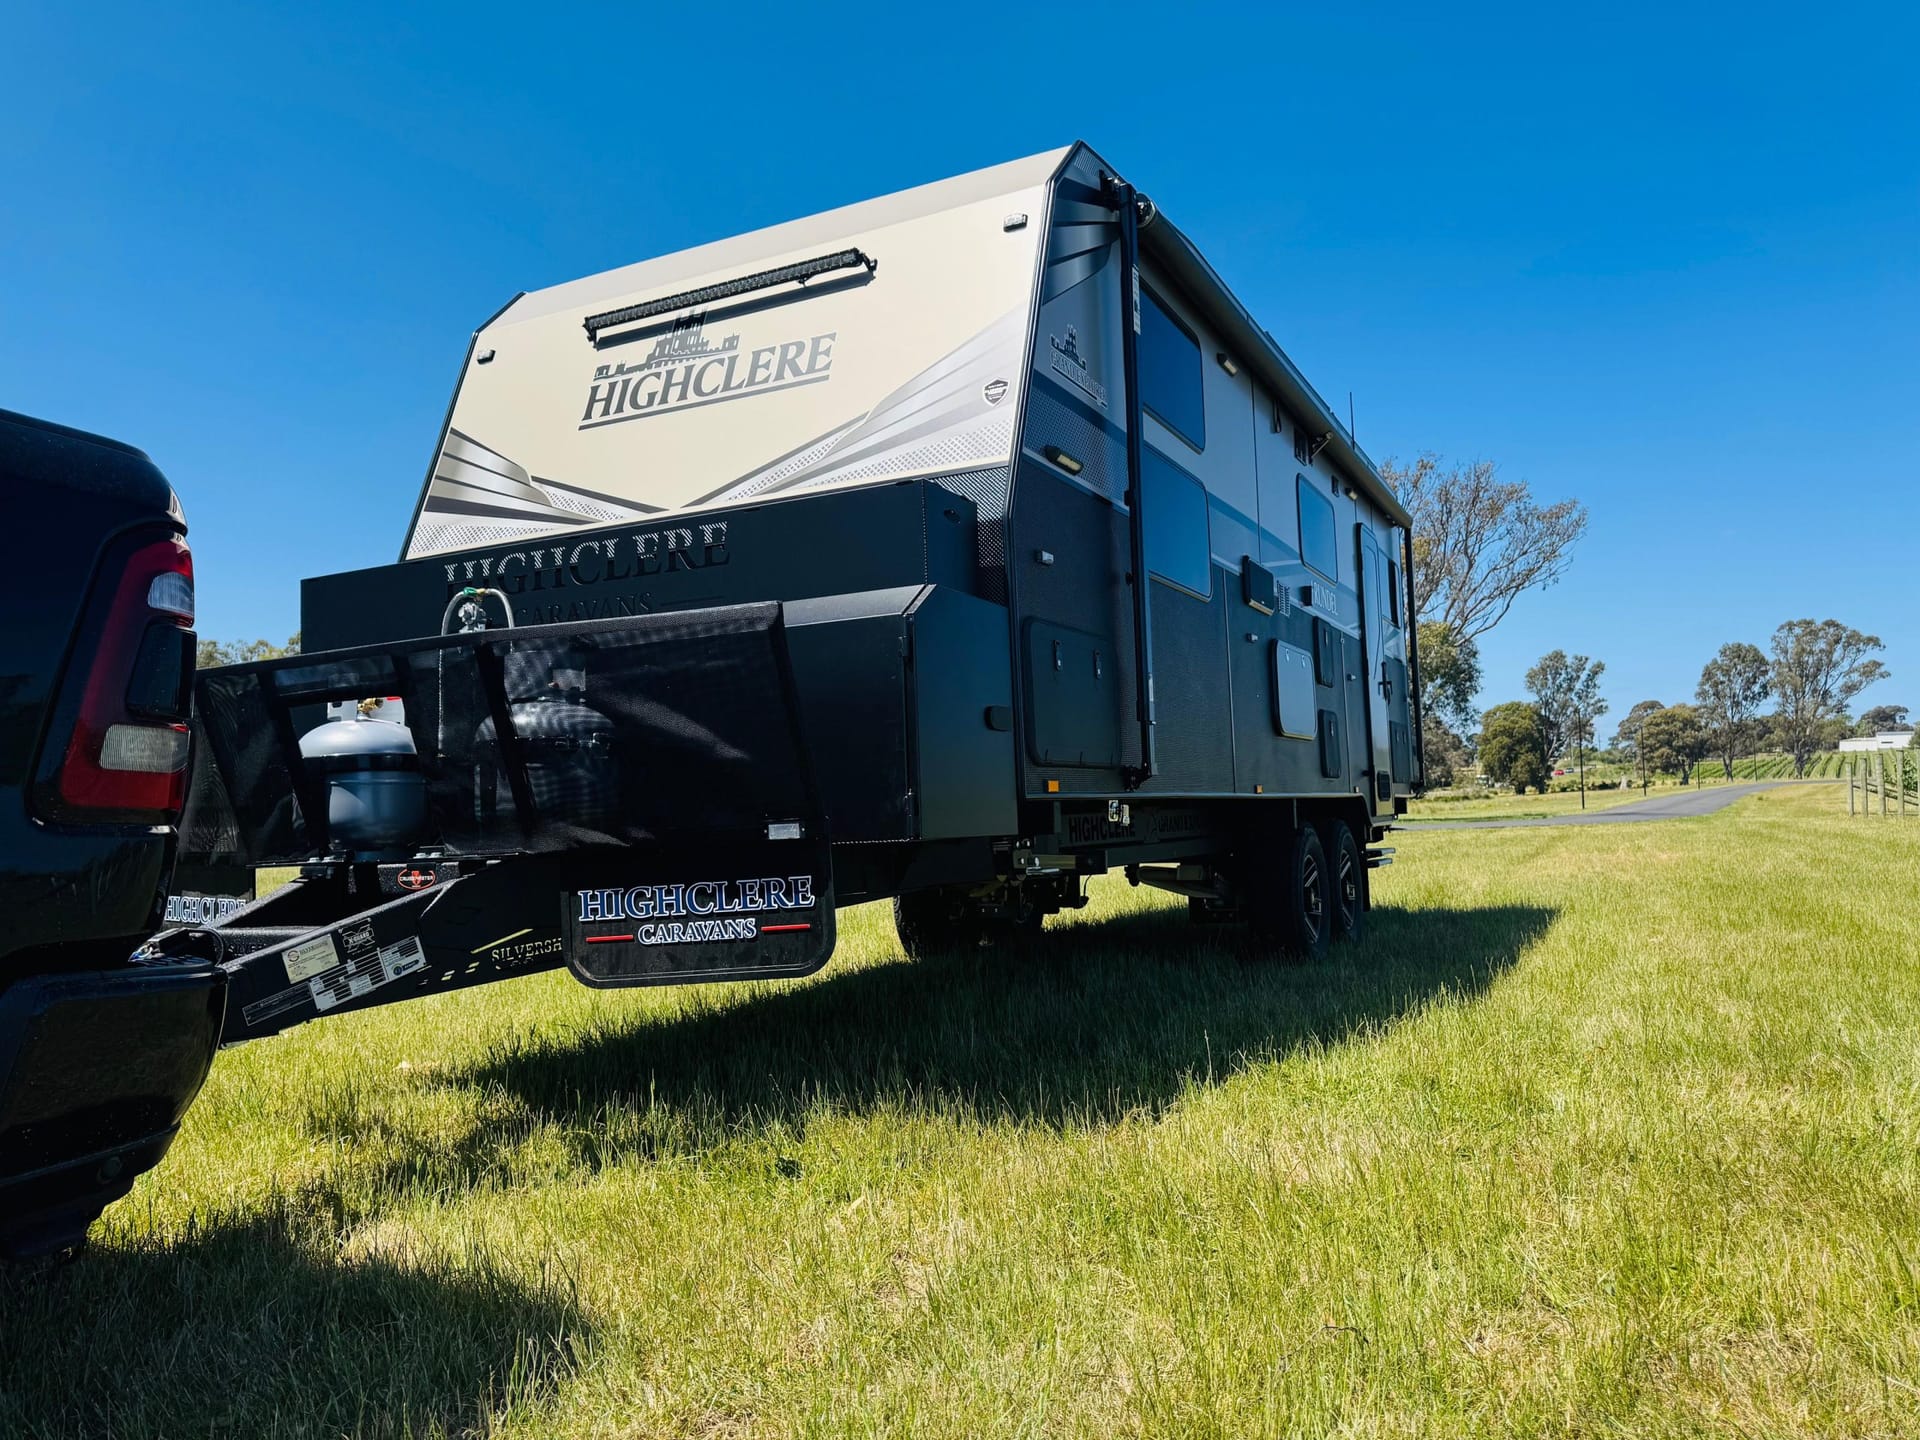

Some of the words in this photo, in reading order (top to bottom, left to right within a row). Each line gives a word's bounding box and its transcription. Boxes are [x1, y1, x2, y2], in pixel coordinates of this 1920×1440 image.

[582, 332, 837, 421] HIGHCLERE
[444, 521, 730, 600] HIGHCLERE
[512, 592, 655, 625] CARAVANS
[579, 875, 816, 922] HIGHCLERE
[637, 918, 757, 945] CARAVANS
